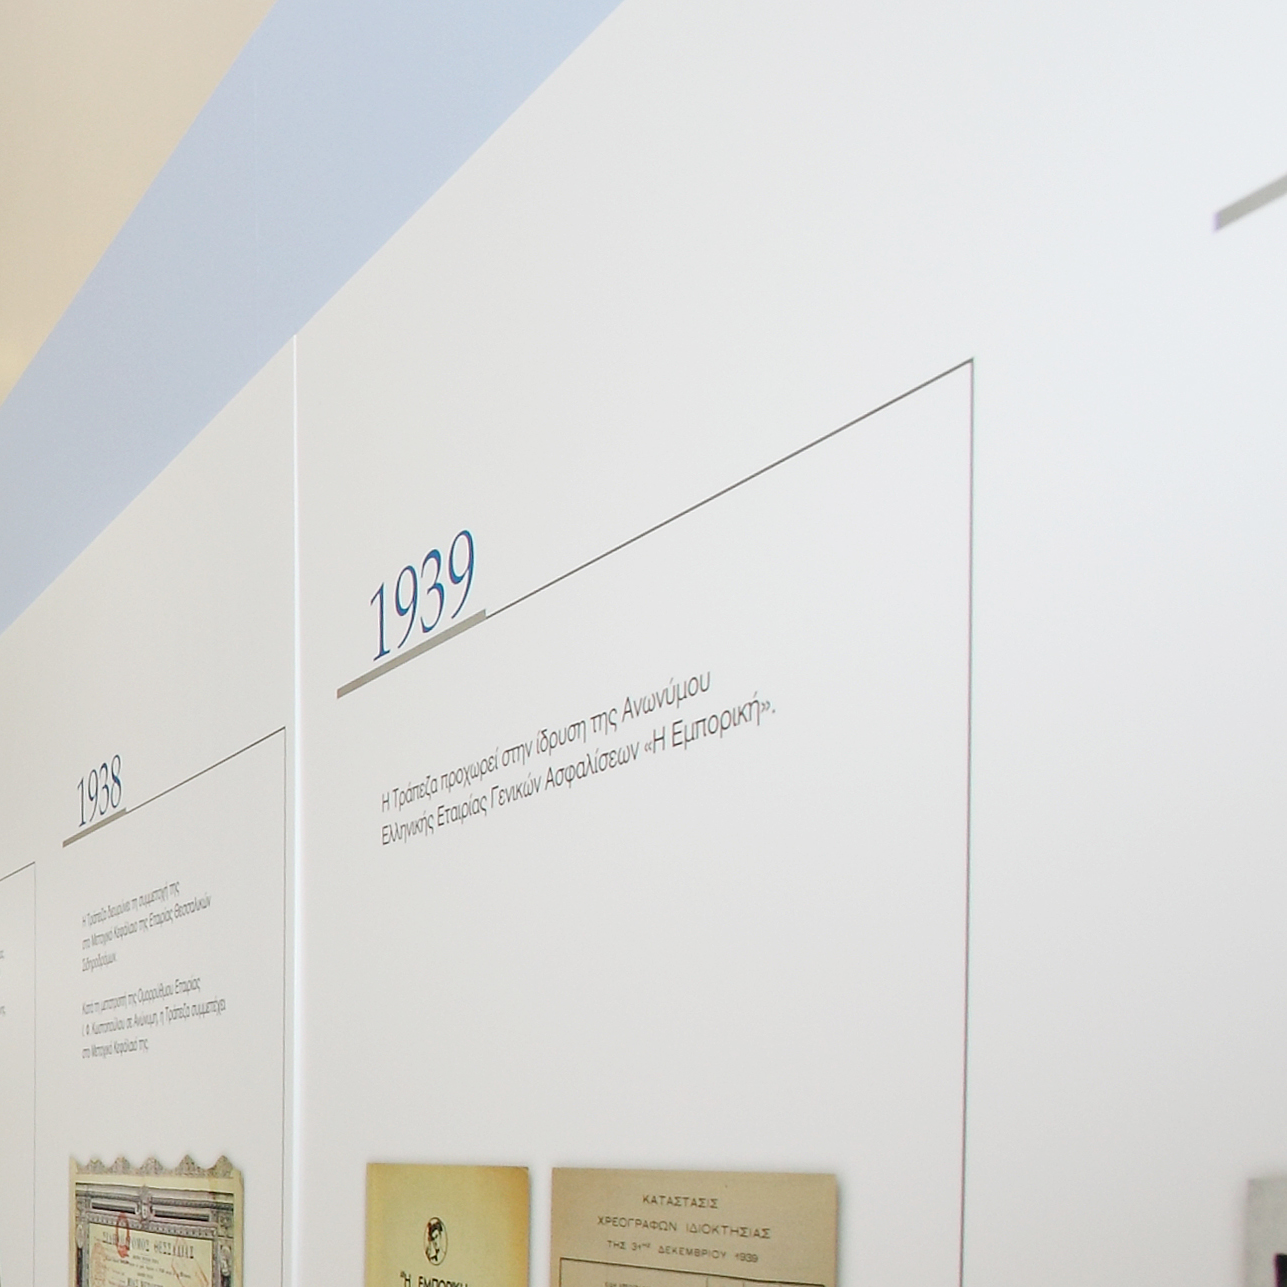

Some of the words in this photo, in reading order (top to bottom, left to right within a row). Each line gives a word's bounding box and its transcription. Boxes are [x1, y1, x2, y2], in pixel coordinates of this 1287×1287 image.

[370, 529, 475, 661] 1939
[392, 775, 438, 812] Τράπεζα
[440, 746, 499, 793] προχωρεί
[501, 740, 533, 768] στην
[536, 719, 587, 756] ίδρυση
[590, 707, 618, 736] της
[621, 671, 711, 723] Ανωνύμου
[77, 754, 122, 828] 1938
[381, 810, 435, 846] Ελληνικής
[437, 793, 488, 827] Εταιρίας
[490, 772, 542, 809] Γενικών
[544, 741, 640, 792] Ασφαλίσεων
[597, 1216, 677, 1231] ΧΡΕΟΓΡΑΦΩΝ
[686, 1223, 771, 1239] ΙΔΙΟΚΤΗΣΙΑΣ
[642, 1194, 718, 1209] ΚΑΤΑΣΤΑΣΙΣ
[658, 1245, 726, 1259] ΔΕΚΕΜΒΡΙΟΥ
[734, 1248, 759, 1263] 1939
